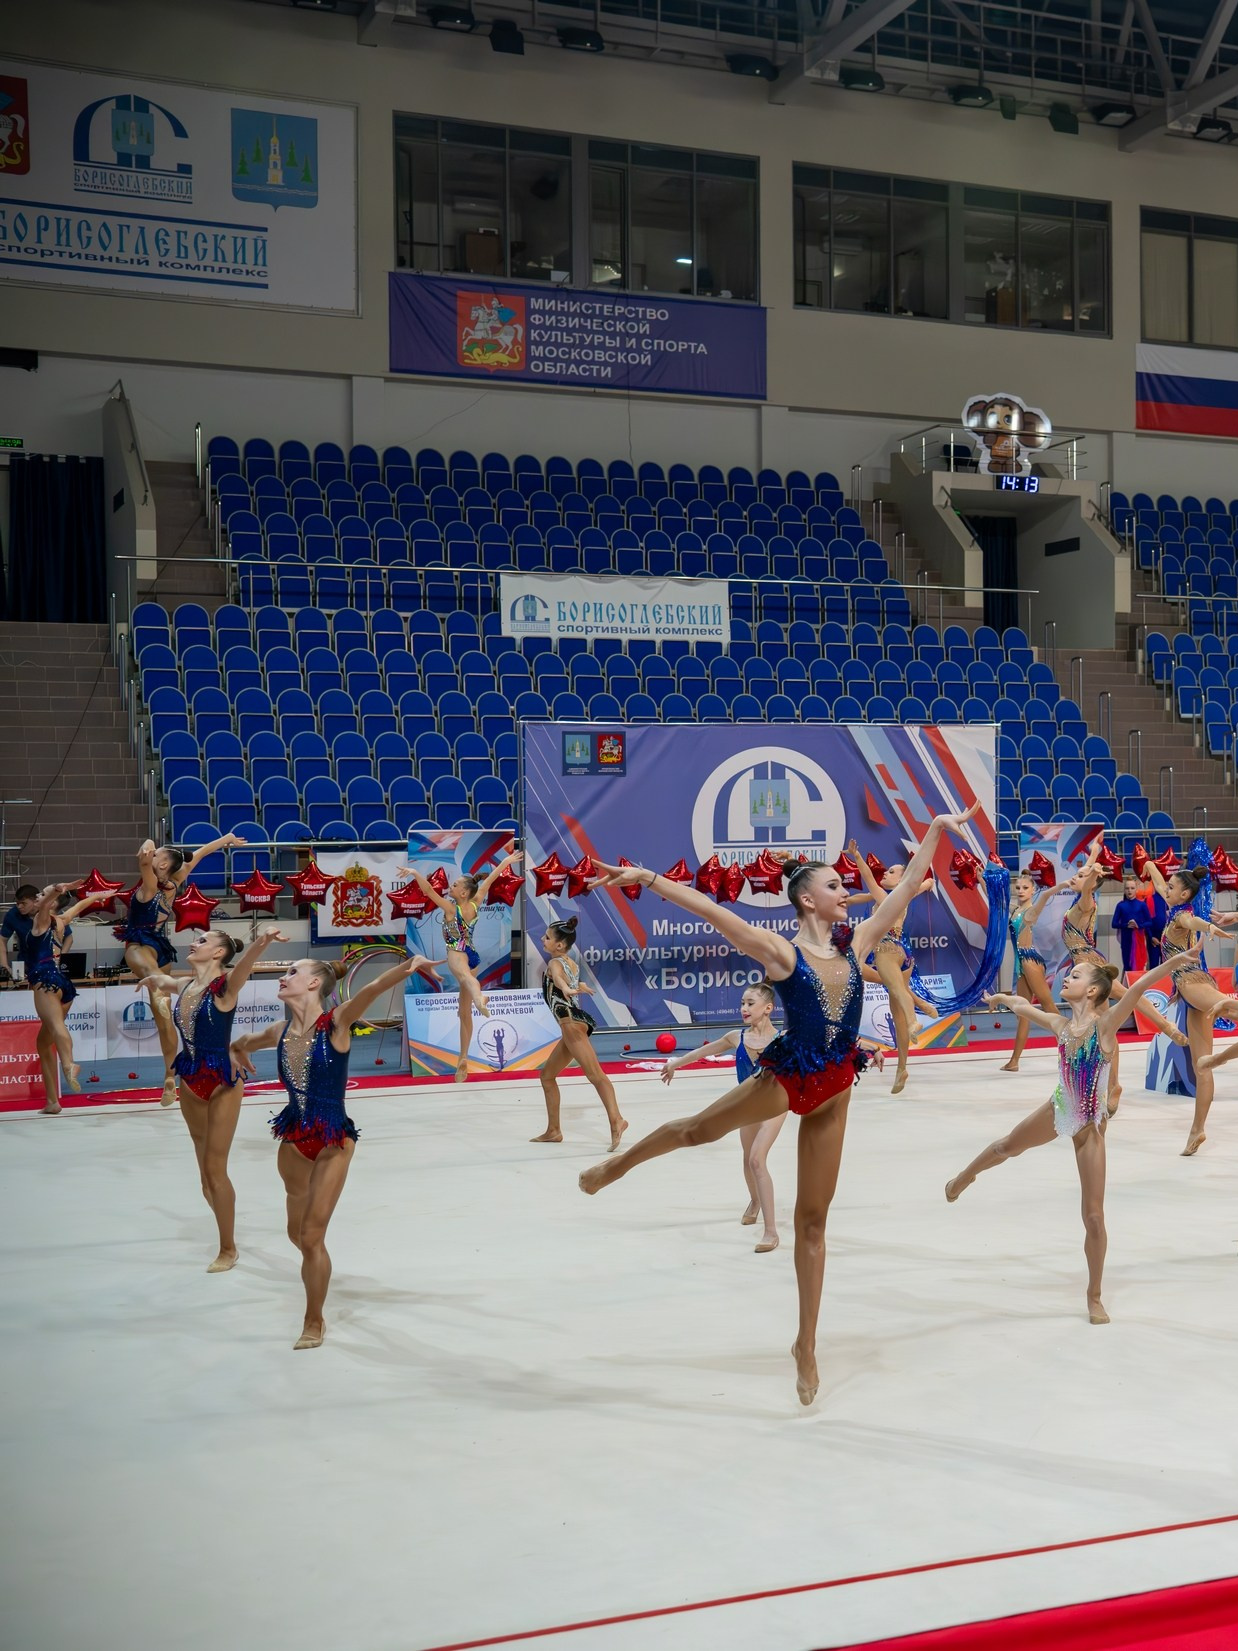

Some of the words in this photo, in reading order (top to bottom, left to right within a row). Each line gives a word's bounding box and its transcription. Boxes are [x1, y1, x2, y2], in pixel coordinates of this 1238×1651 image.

[158, 260, 268, 278] комплекс
[530, 297, 669, 321] МИНИСТЕРСТВО
[530, 313, 650, 335] ФИЗИЧЕСКОЙ
[530, 330, 621, 348] КУЛЬТУРЫ
[626, 338, 637, 349] И
[641, 338, 708, 355] СПОРТА
[530, 345, 651, 366] МОСКОВСКОЙ
[530, 361, 612, 379] ОБЛАСТИ
[1001, 476, 1039, 493] 14:13
[556, 601, 722, 626] БОРИСОГЛЕБСКИЙ
[557, 623, 650, 635] спортивный
[655, 626, 723, 636] комплекс
[300, 881, 326, 890] Тульская
[301, 888, 324, 897] область
[244, 893, 271, 902] Москва
[490, 1006, 534, 1016] ОЛКАЧЕВОЙ
